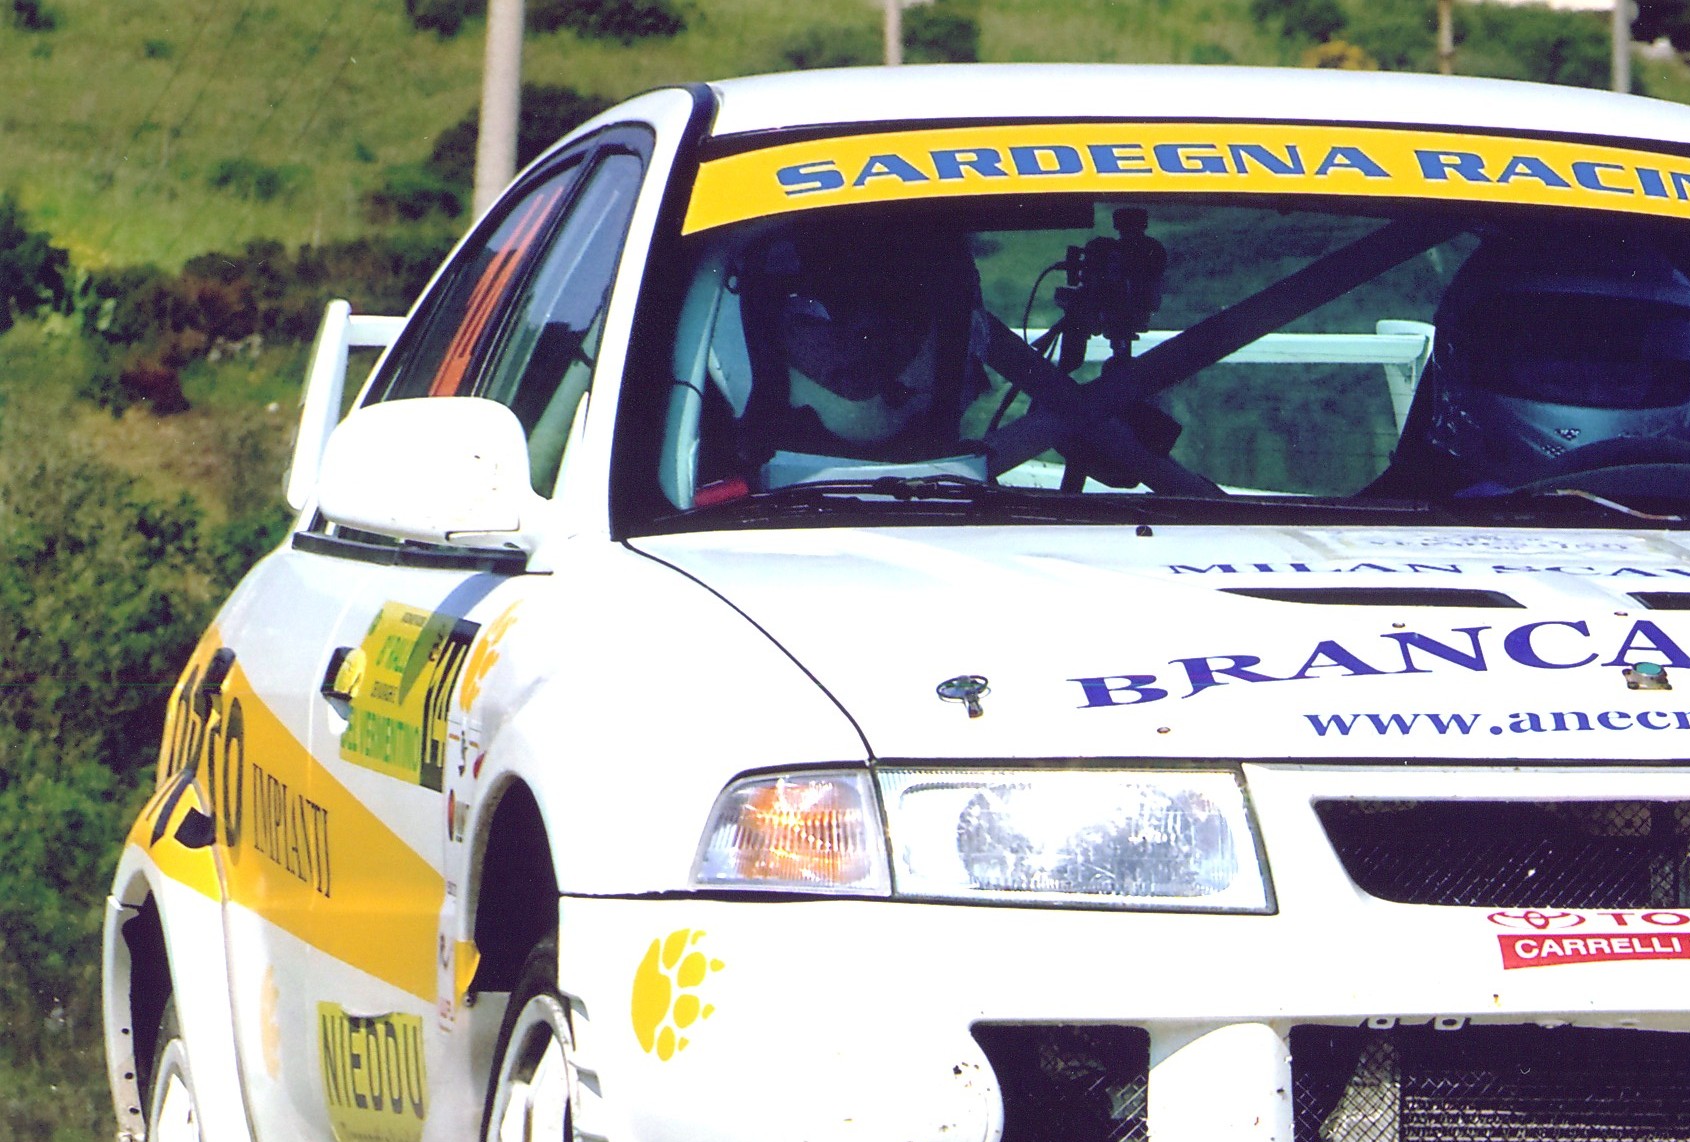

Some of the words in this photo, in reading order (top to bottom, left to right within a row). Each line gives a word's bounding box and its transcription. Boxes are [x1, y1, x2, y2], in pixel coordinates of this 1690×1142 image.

[775, 142, 1391, 197] SARDEGNA
[1167, 562, 1464, 576] MILAN
[1514, 937, 1682, 960] CARRELLI
[322, 1014, 424, 1120] NIEDDU
